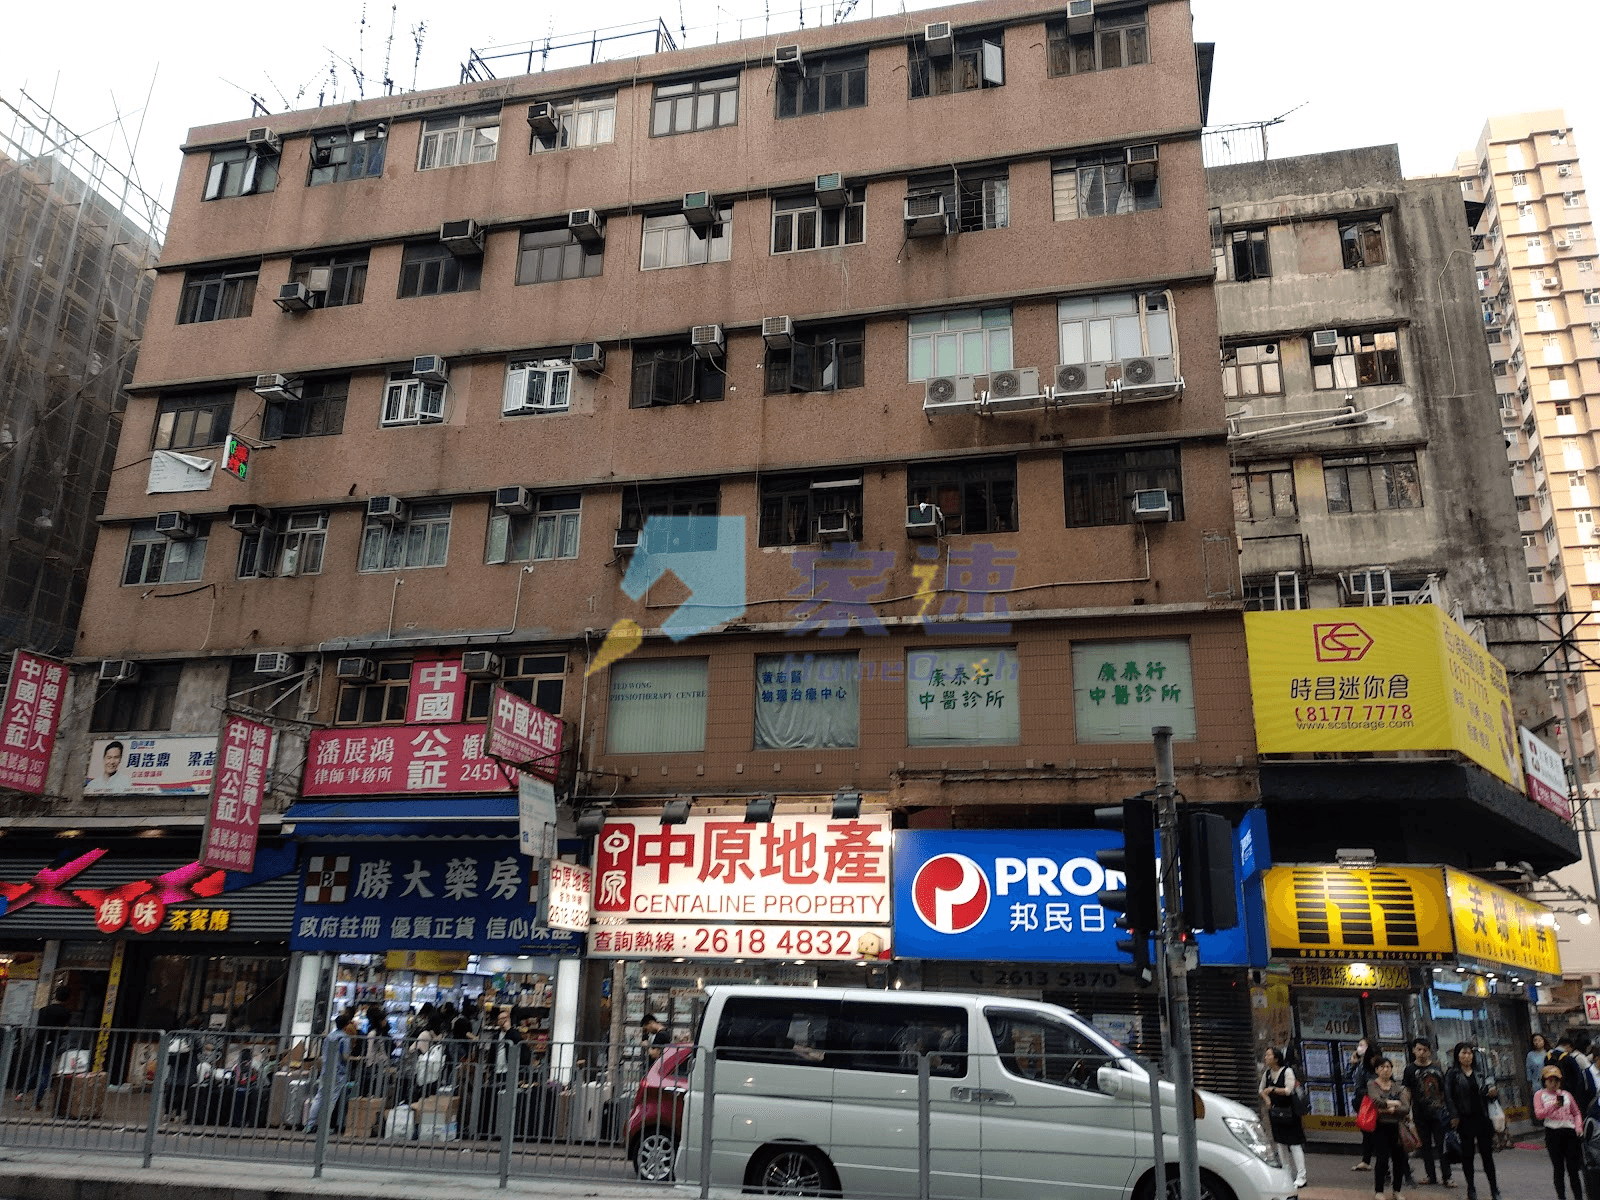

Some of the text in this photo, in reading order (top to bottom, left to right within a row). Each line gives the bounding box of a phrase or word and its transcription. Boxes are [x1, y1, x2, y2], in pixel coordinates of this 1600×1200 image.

[610, 690, 707, 702] PHYSIOTHERAPY CENTRE
[628, 681, 652, 690] WONG
[762, 686, 847, 702] 物理治療中心
[1089, 683, 1182, 706] 中醫診所
[1291, 674, 1409, 701] 時昌迷你倉
[4, 659, 42, 748] 中國公証
[919, 690, 1005, 711] 中醫診所
[498, 694, 557, 751] 中國公証
[1307, 704, 1413, 722] 8177 7778
[407, 662, 457, 790] 中國公証
[1296, 720, 1414, 731] www.scstorage.com
[126, 752, 171, 768] 周浩鼎
[316, 737, 394, 765] 潘展鴻
[216, 720, 249, 822] 中國公証
[314, 766, 391, 785] 律師事務所
[460, 764, 498, 783] 2451
[636, 821, 886, 885] 中原地產
[354, 857, 523, 902] 勝大藥房
[98, 898, 231, 932] 燒味 茶餐廳
[634, 894, 886, 915] CENTALINE PROPERTY
[298, 915, 382, 940] 政府註冊
[391, 915, 476, 940] 優質正貨
[694, 928, 766, 953] 2618
[776, 930, 853, 956] 4832
[995, 970, 1117, 988] 2613 5870
